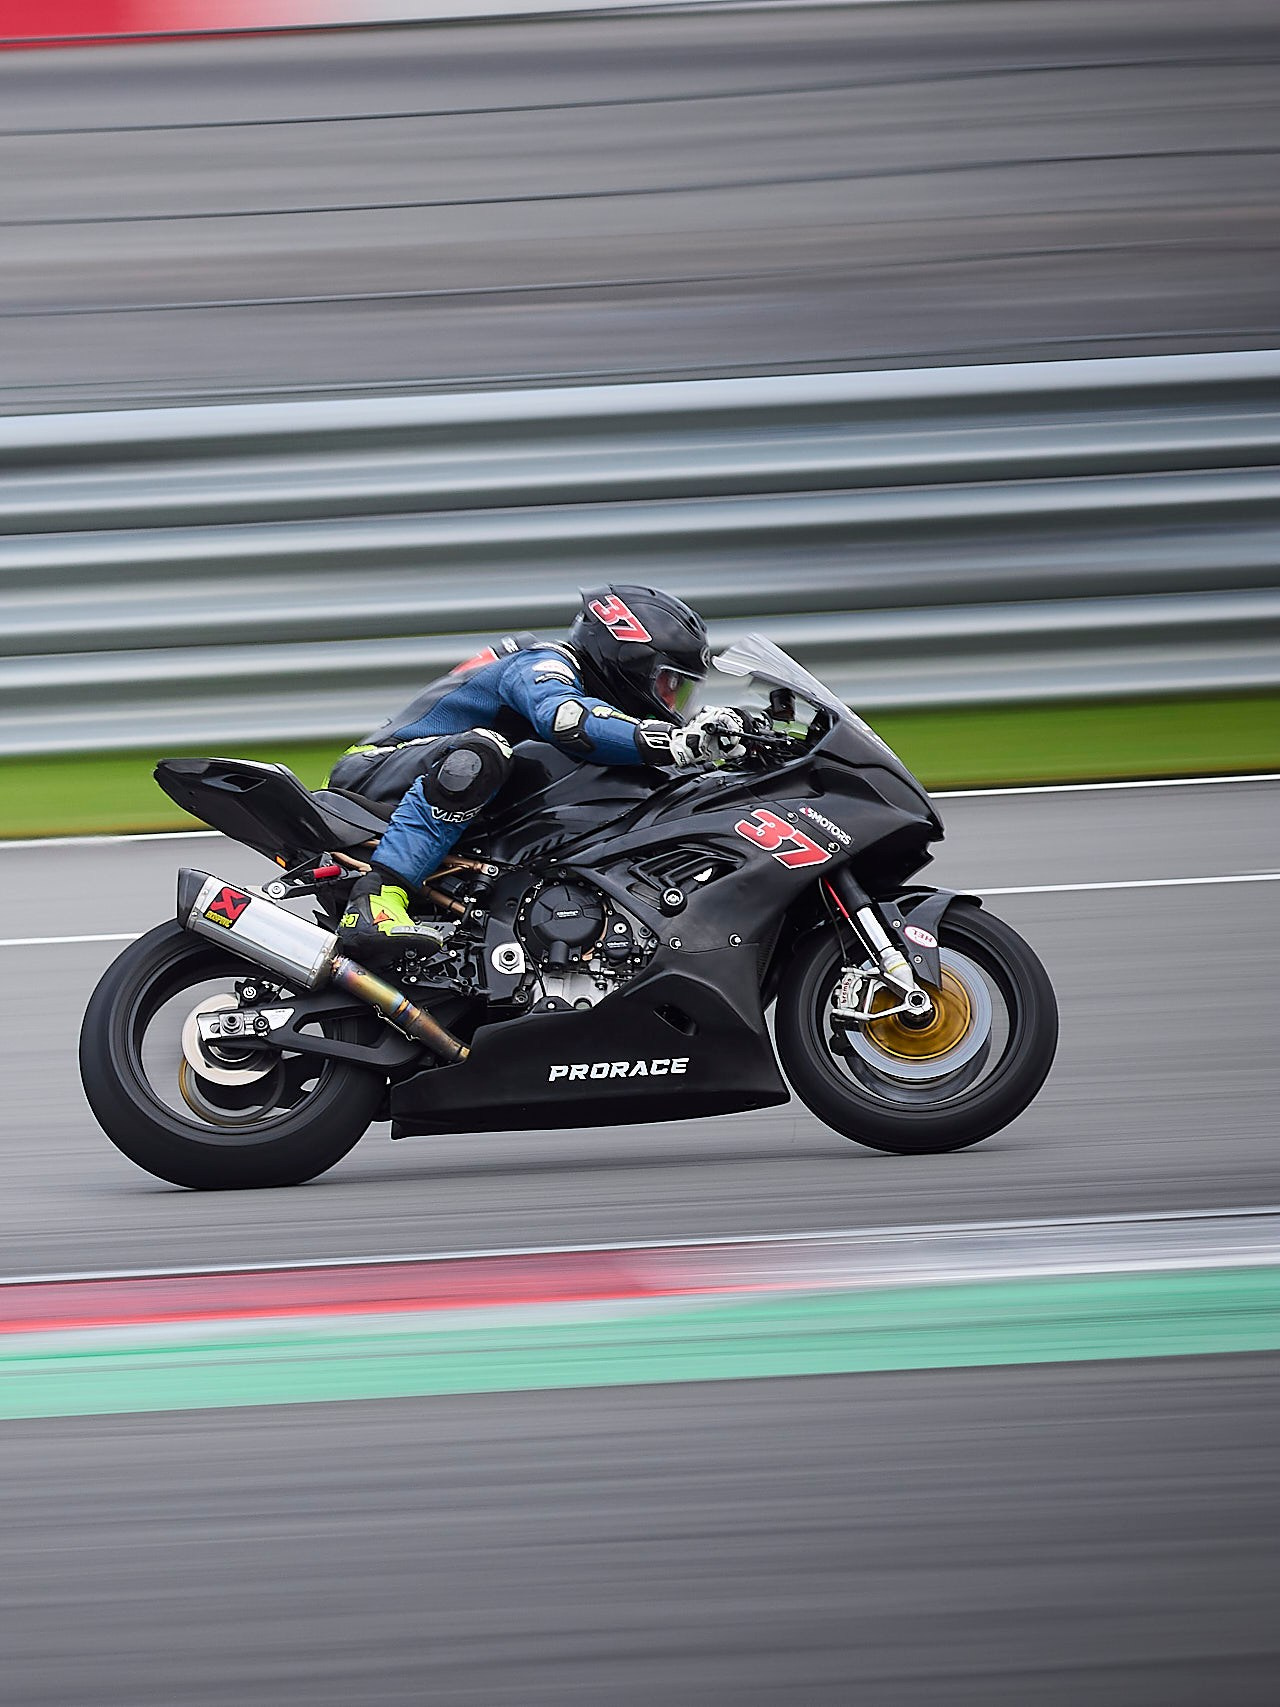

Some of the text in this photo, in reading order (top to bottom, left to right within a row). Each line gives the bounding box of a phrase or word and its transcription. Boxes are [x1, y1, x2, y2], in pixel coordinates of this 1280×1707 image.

[588, 594, 653, 642] 37
[431, 803, 486, 823] VIRC
[734, 808, 833, 869] 37
[548, 1057, 690, 1082] PRORACE
